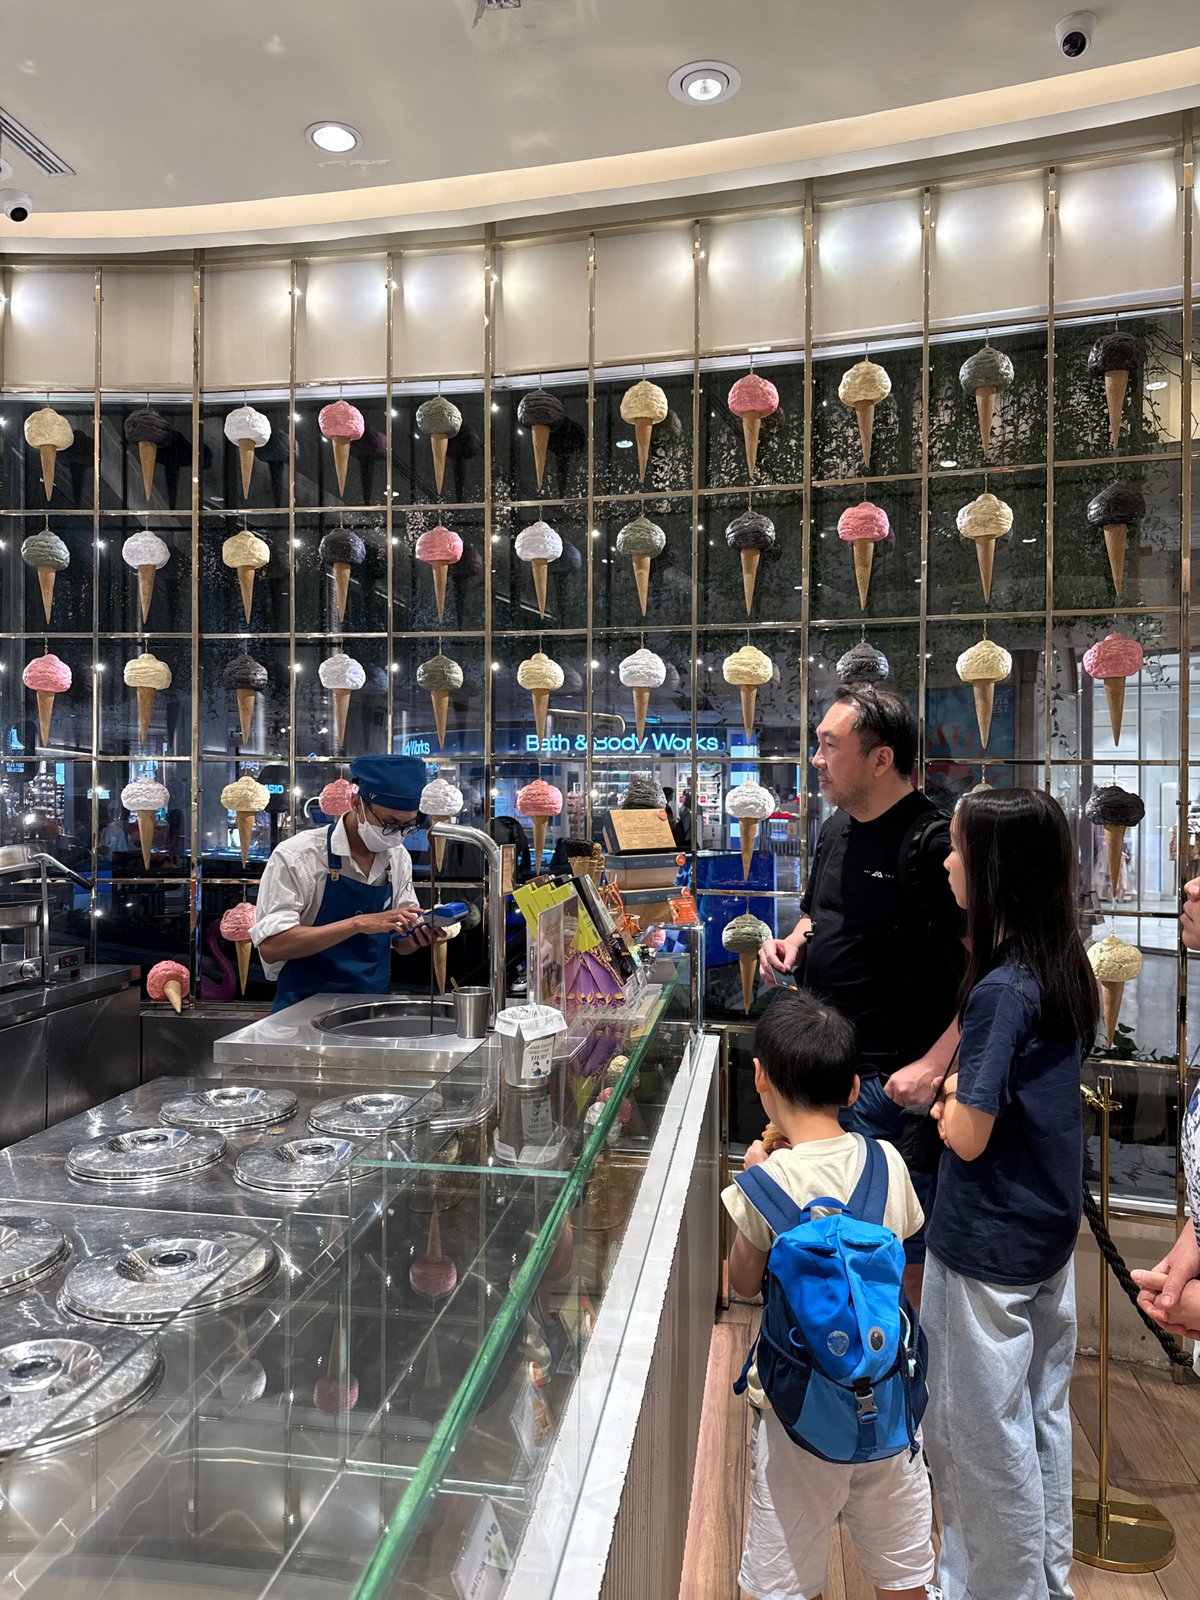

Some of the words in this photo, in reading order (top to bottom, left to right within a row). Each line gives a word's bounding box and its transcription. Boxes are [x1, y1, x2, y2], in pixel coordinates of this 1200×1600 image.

[526, 733, 570, 752] Bath
[574, 734, 587, 751] &
[593, 733, 648, 754] Body
[652, 733, 718, 751] Works
[264, 784, 284, 794] ASIO
